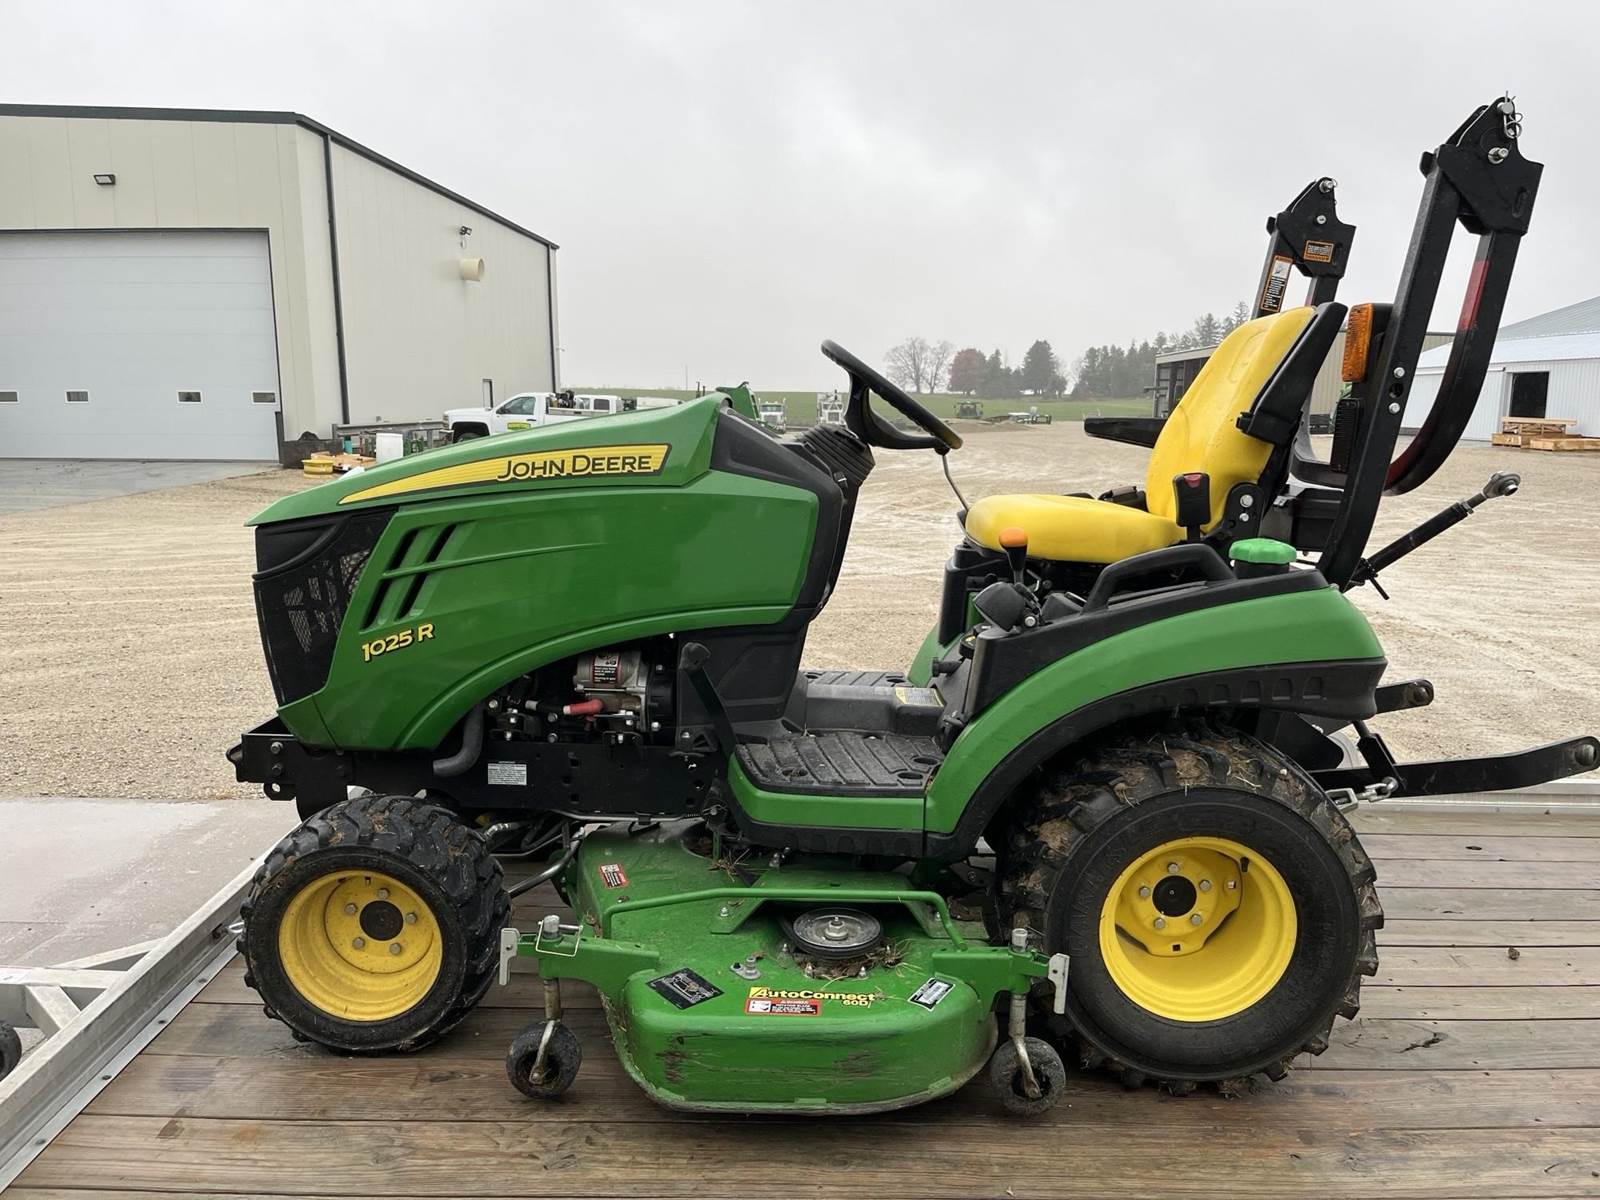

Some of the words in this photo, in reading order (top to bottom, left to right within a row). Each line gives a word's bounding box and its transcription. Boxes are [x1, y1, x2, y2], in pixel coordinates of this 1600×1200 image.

[497, 459, 565, 480] JOHN
[572, 455, 653, 473] DEERE
[362, 629, 413, 661] 1025
[418, 623, 433, 641] R
[749, 987, 875, 1001] AutoConnect
